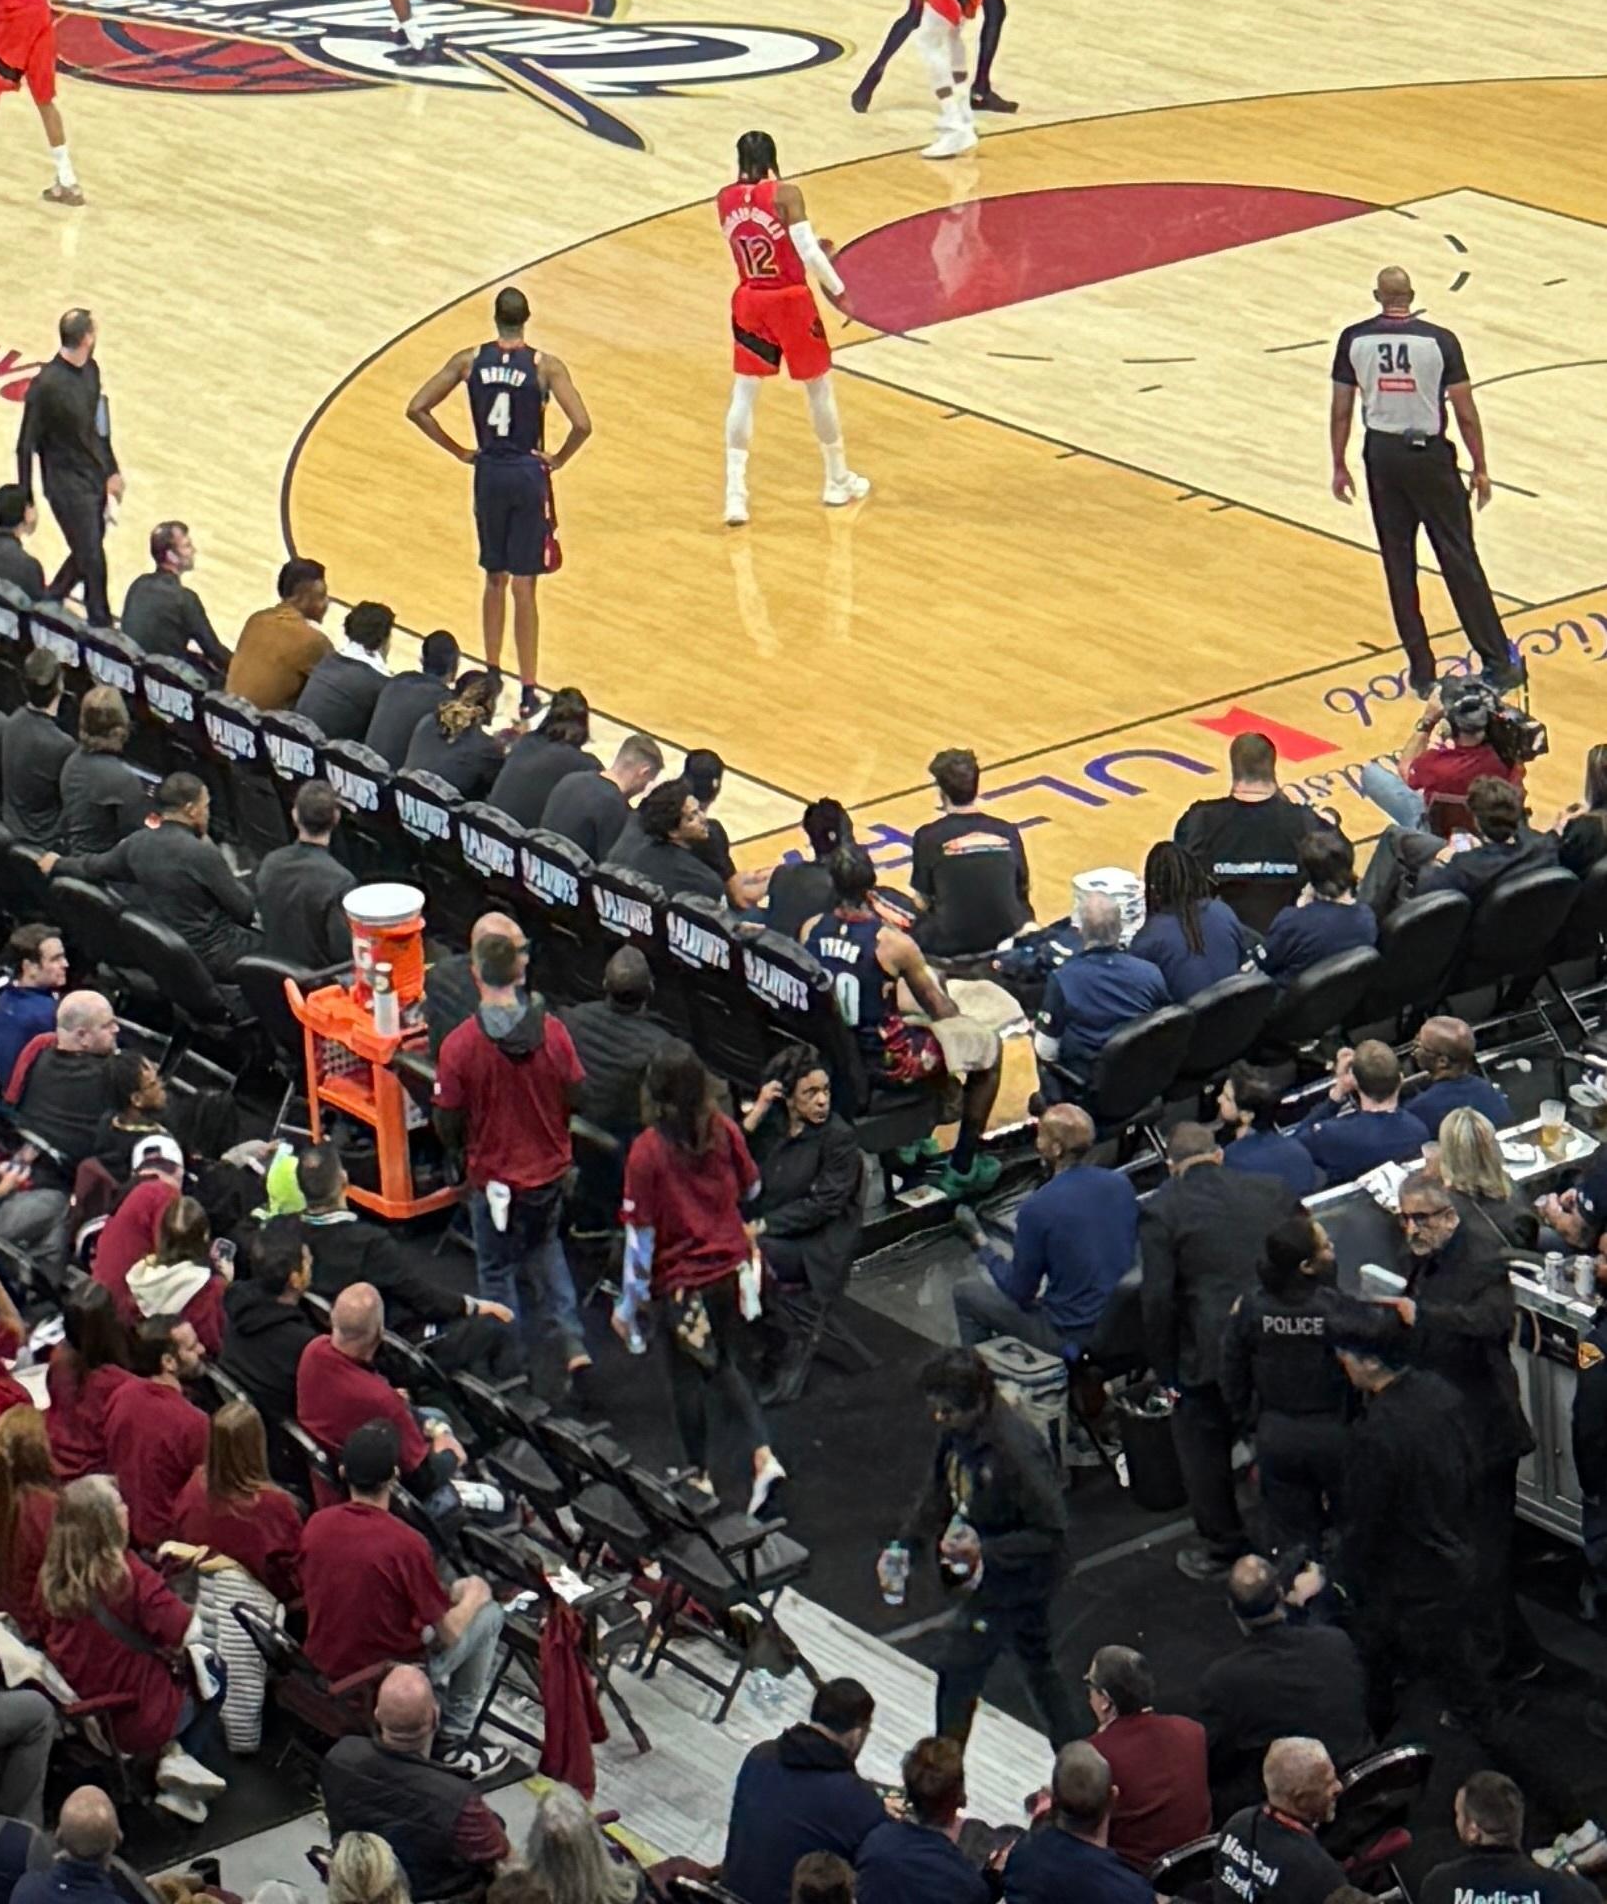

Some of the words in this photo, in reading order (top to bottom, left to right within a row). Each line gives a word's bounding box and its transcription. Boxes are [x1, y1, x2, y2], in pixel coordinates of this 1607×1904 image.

[739, 234, 779, 279] 12
[1378, 343, 1411, 374] 34
[487, 392, 511, 437] 4
[1262, 1316, 1325, 1336] POLICE
[1454, 1888, 1541, 1904] Medical
